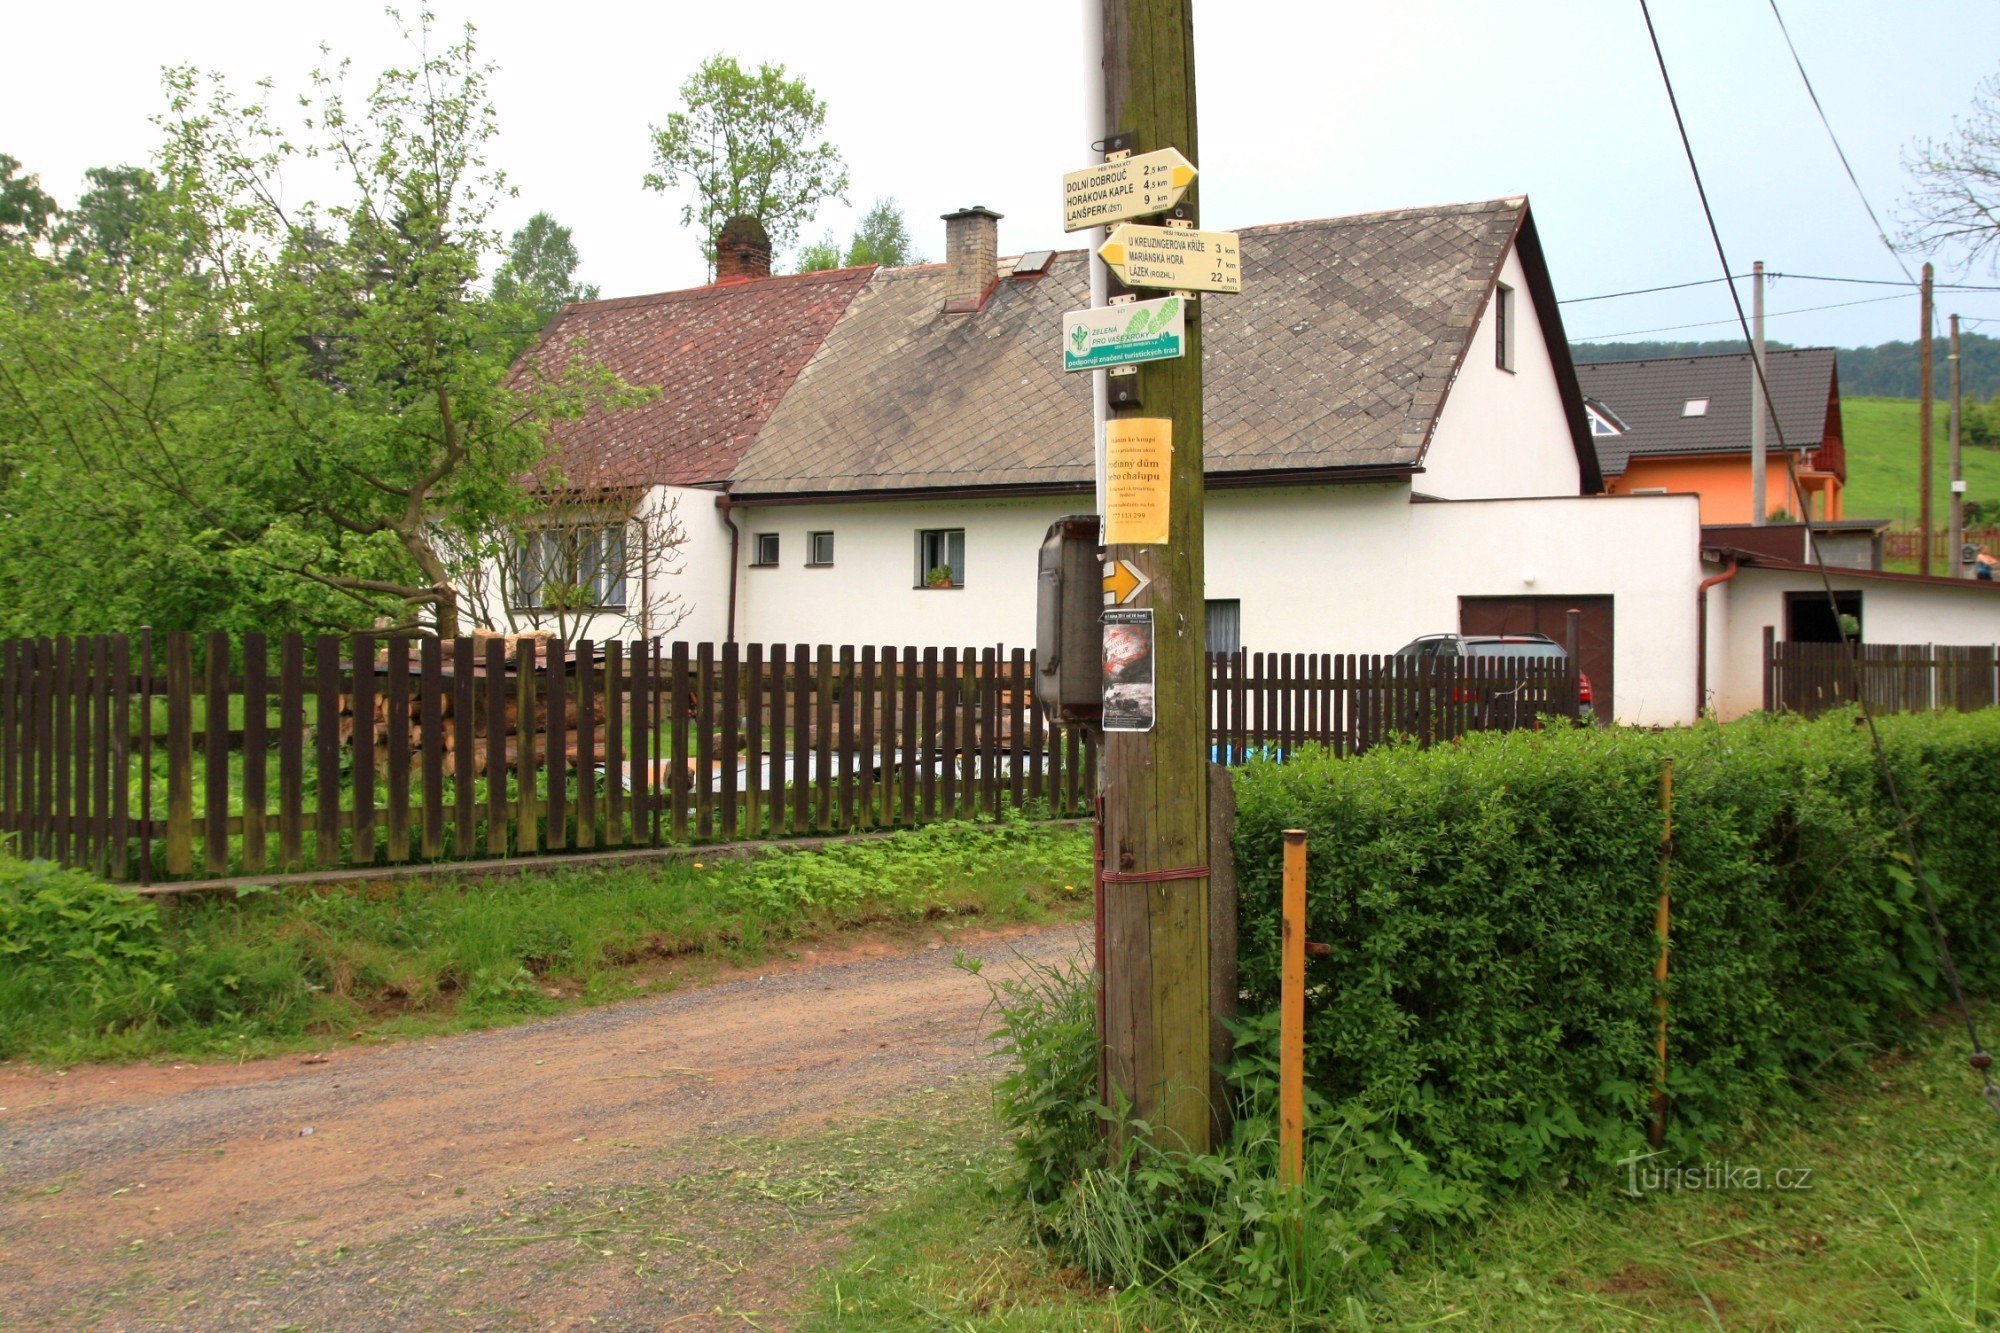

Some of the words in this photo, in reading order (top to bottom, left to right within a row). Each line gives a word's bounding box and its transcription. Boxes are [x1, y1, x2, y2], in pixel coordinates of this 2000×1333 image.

[1066, 177, 1089, 193] DOLNÍ
[1090, 170, 1127, 188] DOBROUČ
[1143, 166, 1156, 176] 2,5
[1067, 190, 1108, 207] HORÁKOVA
[1109, 184, 1134, 197] KAPLE
[1143, 180, 1156, 190] 4,5
[1067, 204, 1107, 221] LANŠPERK
[1108, 204, 1122, 214] (ŽST)
[1144, 195, 1150, 205] 9
[1129, 237, 1133, 246] U
[1134, 237, 1186, 250] KREUZINGEROVA
[1187, 238, 1205, 252] KŘÍŽE
[1216, 244, 1221, 253] 3
[1225, 247, 1235, 255] km
[1129, 251, 1165, 264] MARIÁNSKÁ
[1166, 255, 1184, 265] HORA
[1216, 258, 1222, 268] 7
[1226, 261, 1236, 269] km
[1130, 266, 1149, 277] LÁZEK
[1211, 272, 1222, 282] 22
[1092, 326, 1118, 336] ZELENÁ
[1108, 334, 1124, 343] VAŠE
[1125, 332, 1150, 341] KROKY
[1068, 357, 1098, 368] podporují
[1099, 353, 1123, 362] značení
[1124, 348, 1162, 359] turistických
[1137, 459, 1159, 467] dům
[1122, 471, 1160, 483] chalupu
